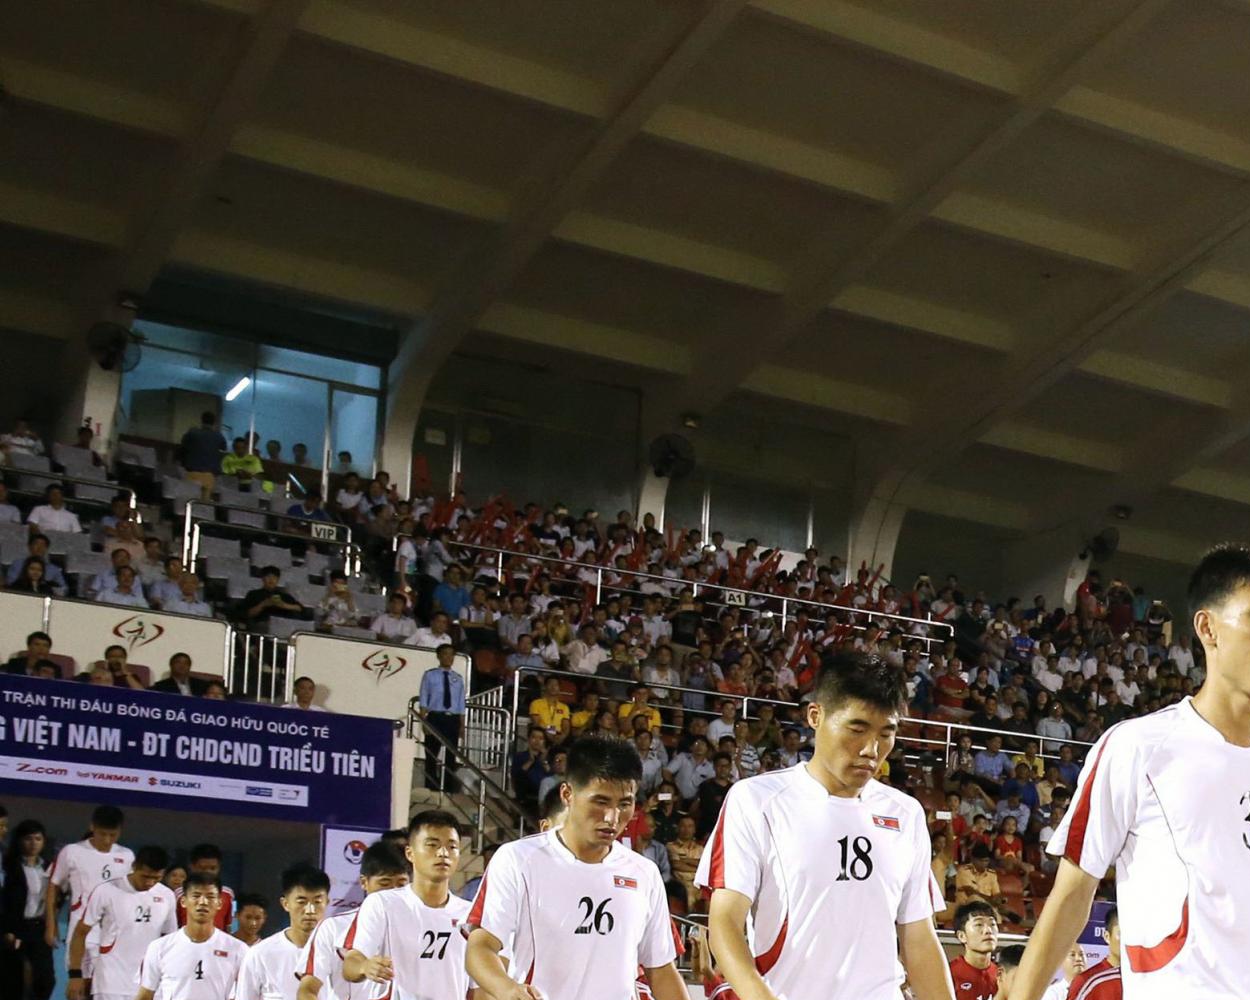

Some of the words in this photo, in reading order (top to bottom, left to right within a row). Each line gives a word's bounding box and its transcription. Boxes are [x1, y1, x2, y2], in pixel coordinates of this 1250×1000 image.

[315, 527, 334, 538] VIP
[728, 593, 742, 603] A1
[50, 695, 76, 710] THI
[116, 703, 162, 719] BÓNG
[165, 708, 187, 722] ĐÁ
[191, 713, 227, 727] GIAO
[13, 715, 63, 751] VIỆT
[68, 723, 121, 752] NAM
[142, 731, 170, 757] ĐT
[176, 735, 262, 767] CHDCND
[331, 749, 376, 778] TIÊN
[91, 772, 140, 783] YANMAR
[160, 778, 201, 790] SUZUKI
[835, 835, 874, 881] 18
[102, 864, 111, 880] 6
[134, 906, 152, 923] 24
[574, 896, 615, 936] 26
[420, 930, 451, 960] 27
[195, 960, 204, 980] 4
